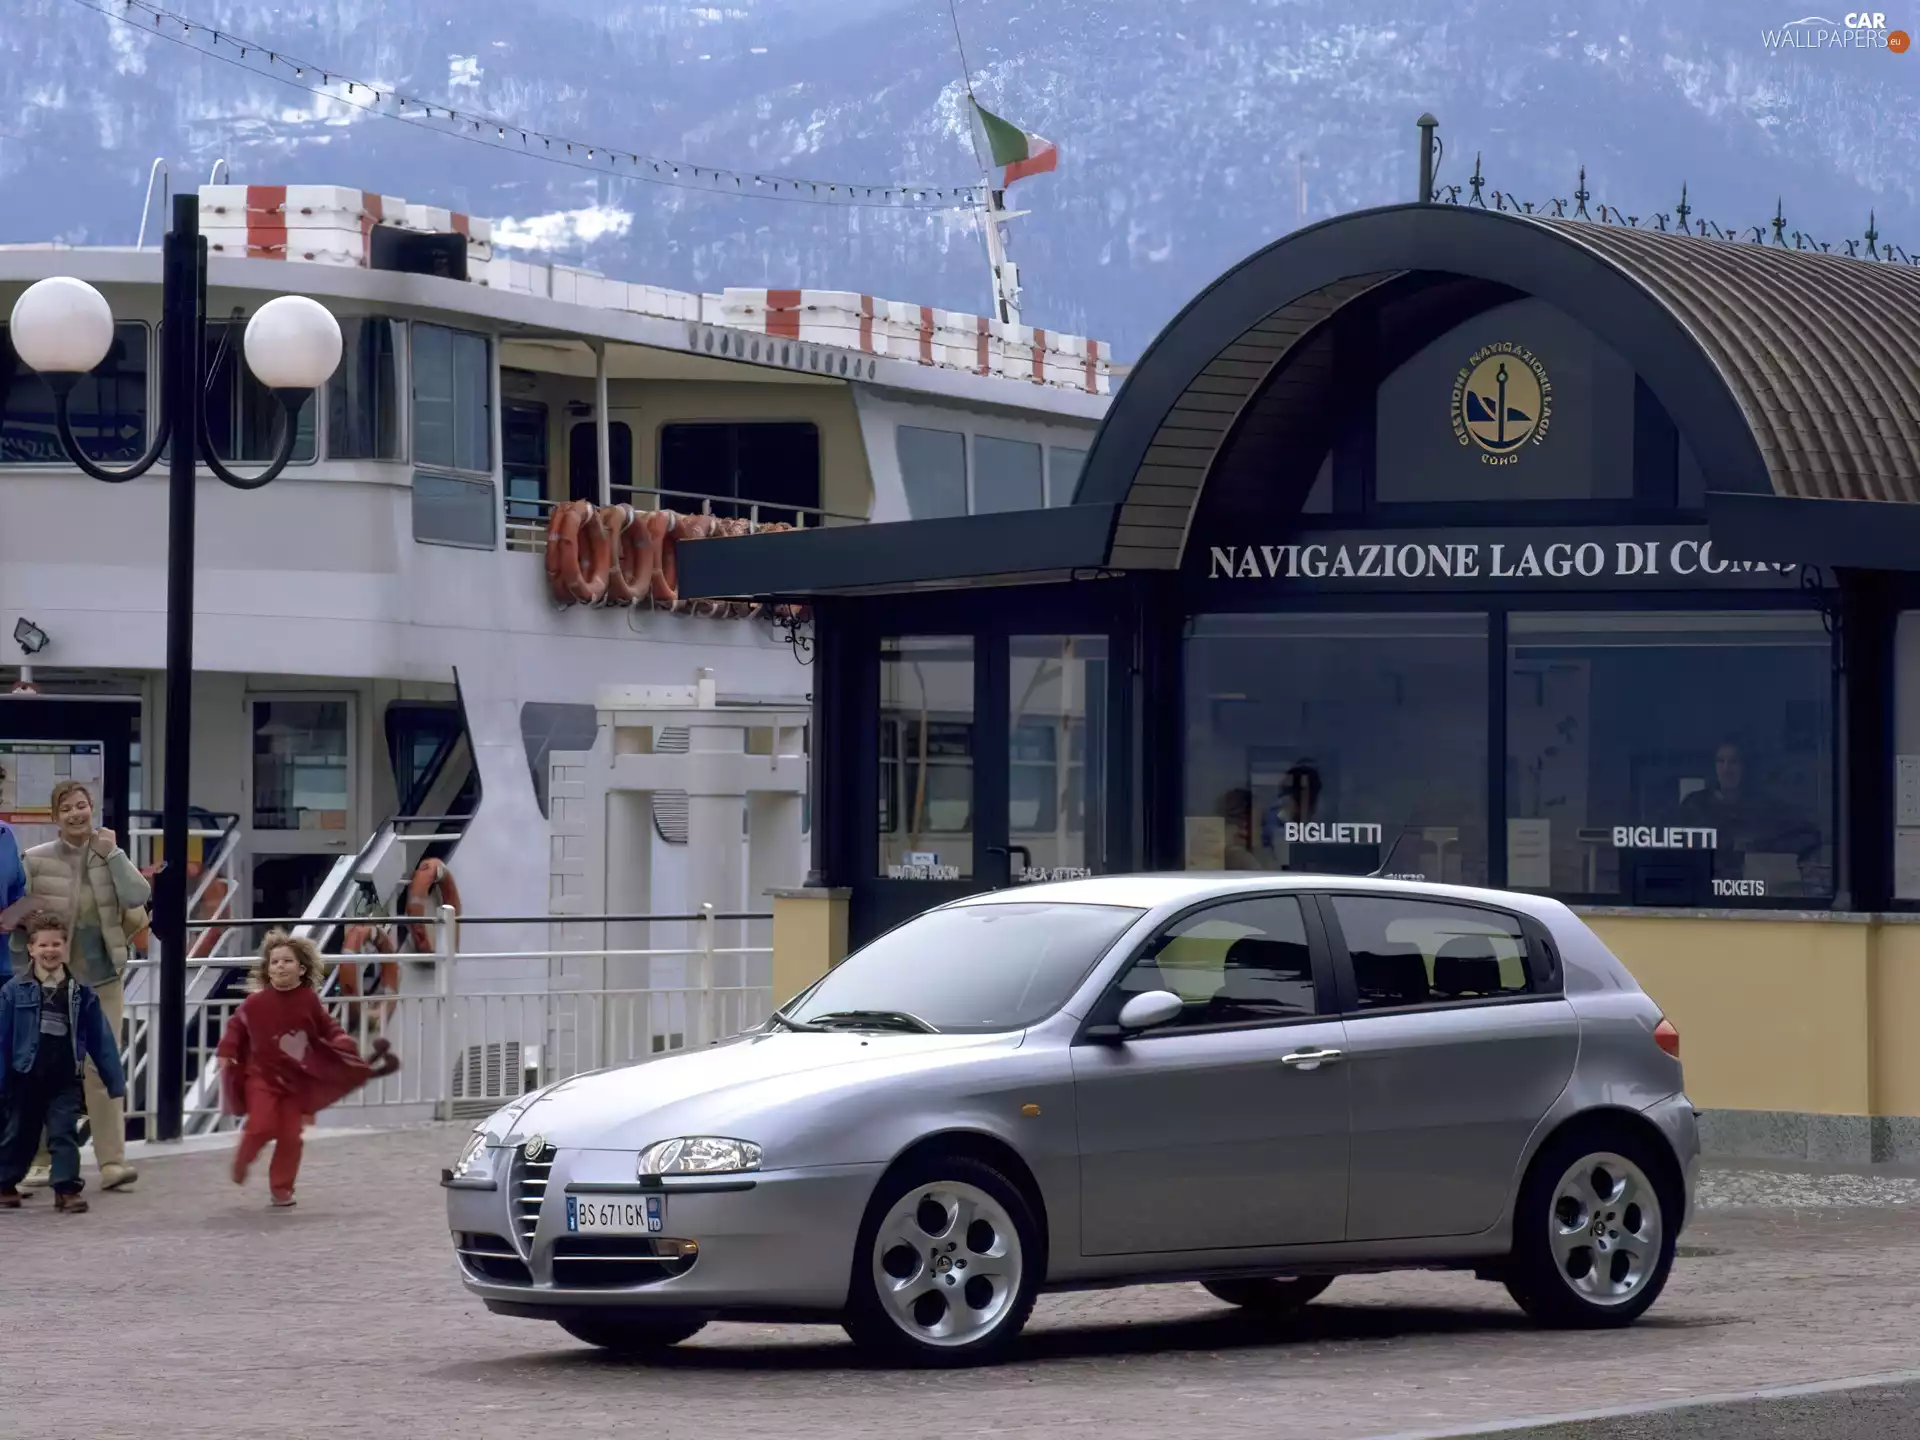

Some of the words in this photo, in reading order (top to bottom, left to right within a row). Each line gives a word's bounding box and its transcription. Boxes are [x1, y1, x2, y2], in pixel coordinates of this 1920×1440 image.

[1481, 453, 1518, 465] COMO
[1208, 544, 1480, 579] NAVIGAZIONE
[1489, 543, 1605, 577] LAGO
[1615, 541, 1660, 575] DI
[1670, 540, 1797, 575] CO
[1285, 822, 1381, 843] BIGLIETTI
[1613, 826, 1717, 849] BIGLIETTI
[1711, 879, 1764, 896] TICKETS
[579, 1203, 596, 1226] BS
